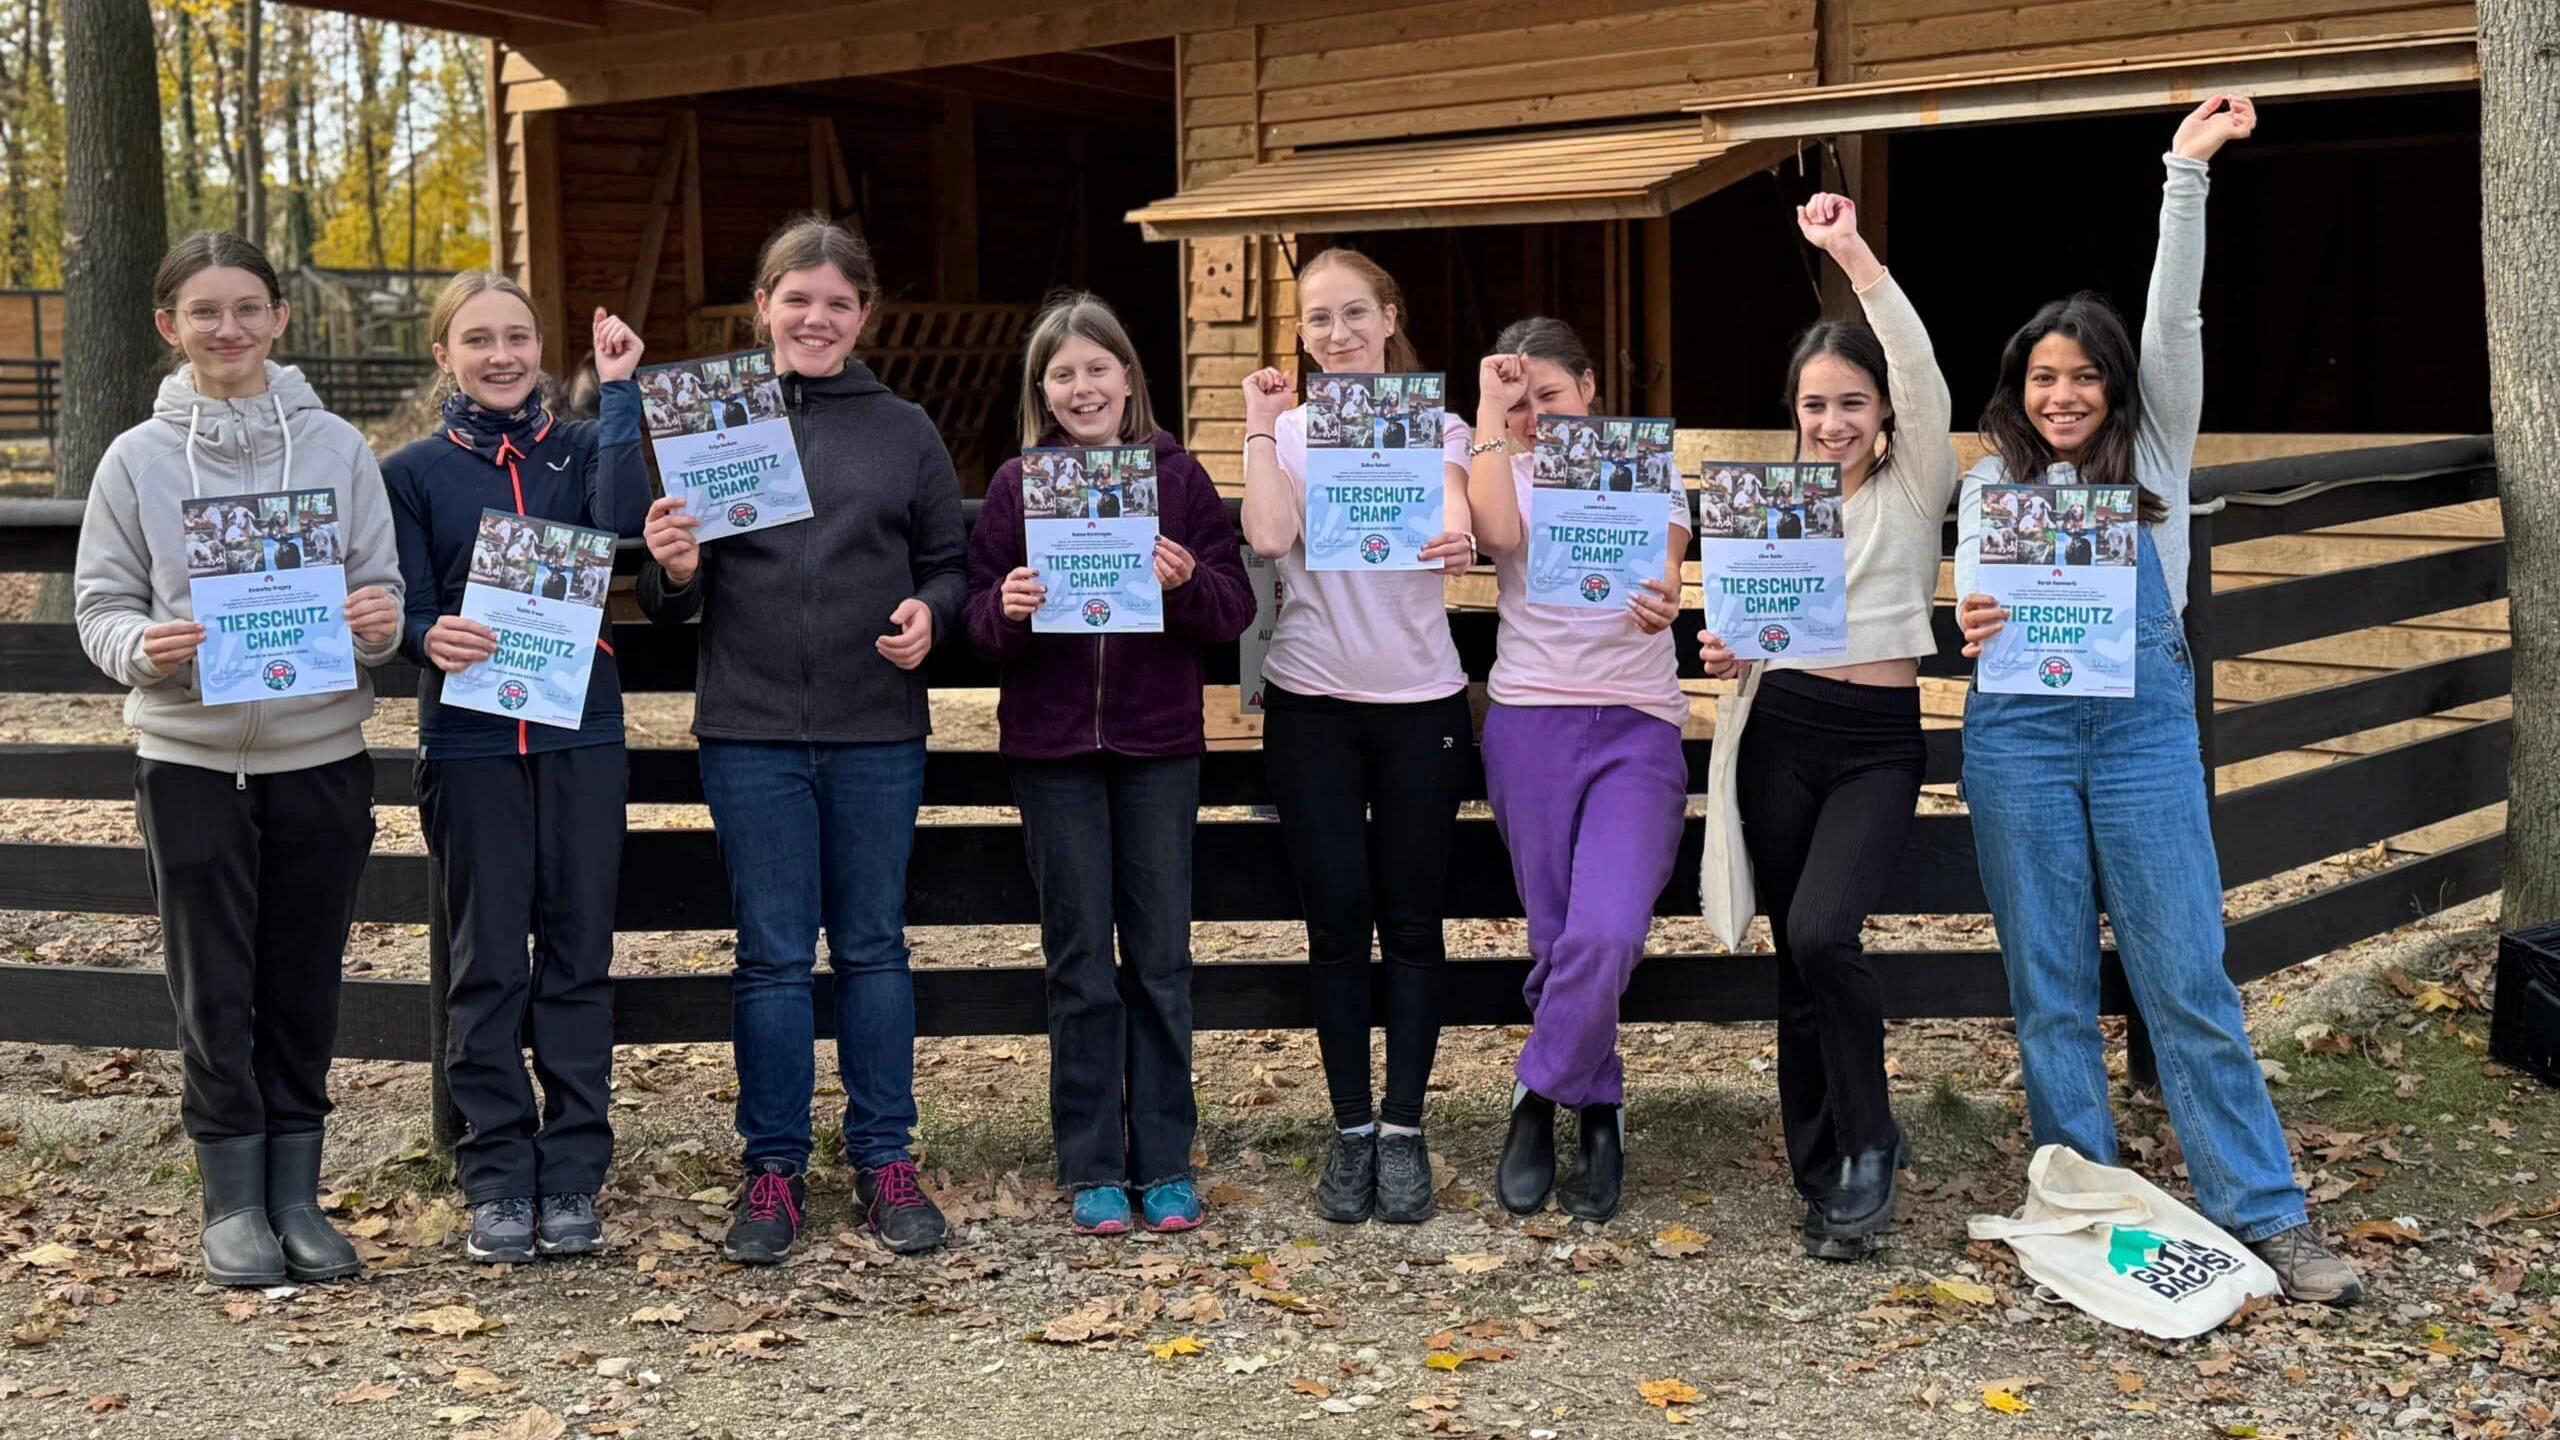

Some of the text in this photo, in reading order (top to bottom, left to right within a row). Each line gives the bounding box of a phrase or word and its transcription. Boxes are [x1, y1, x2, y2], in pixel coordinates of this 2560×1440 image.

[680, 453, 780, 488] TIERSCHUTZ
[708, 476, 760, 500] CHAMP
[1325, 486, 1425, 504] TIERSCHUTZ
[1349, 505, 1402, 522] CHAMP
[1549, 525, 1649, 546] TIERSCHUTZ
[1046, 553, 1142, 571] TIERSCHUTZ
[1571, 545, 1624, 564] CHAMP
[1069, 572, 1120, 588] CHAMP
[1720, 577, 1825, 595] TIERSCHUTZ
[1745, 596, 1801, 614] CHAMP
[216, 606, 329, 633] TIERSCHUTZ
[246, 630, 305, 651] CHAMP
[491, 627, 576, 659] RSCHUTZ
[2027, 625, 2086, 645] CHAMP
[493, 647, 548, 672] CHAMP
